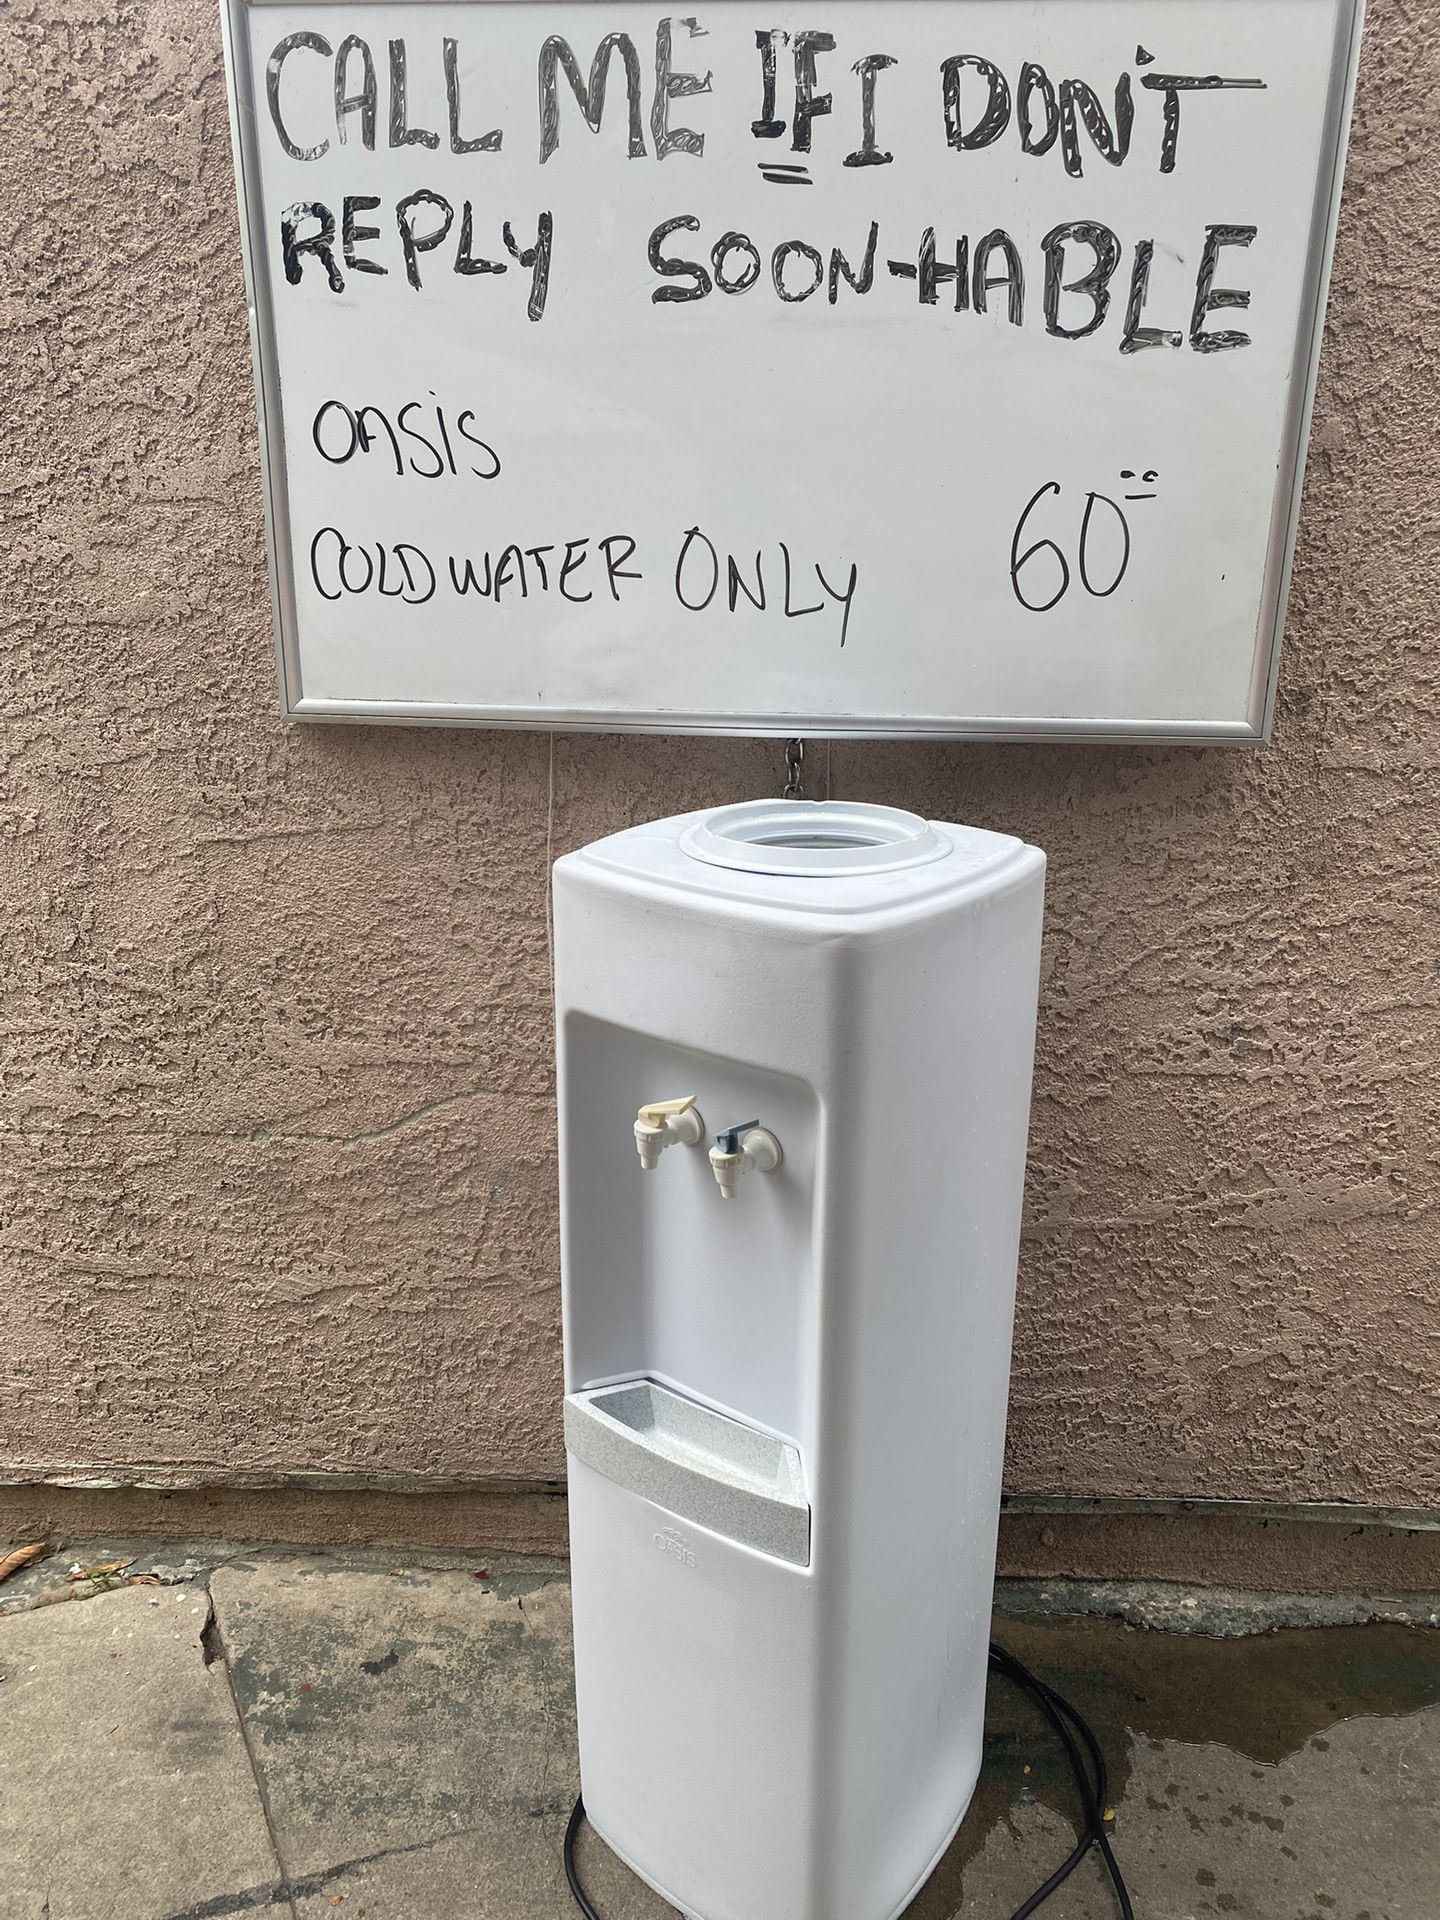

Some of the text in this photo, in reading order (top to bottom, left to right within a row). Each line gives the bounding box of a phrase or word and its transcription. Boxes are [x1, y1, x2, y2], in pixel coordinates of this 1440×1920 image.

[265, 16, 1268, 178] CALL ME IF I DON'T
[280, 188, 554, 322] REPLY
[310, 525, 858, 648] COLD WATER ONLY
